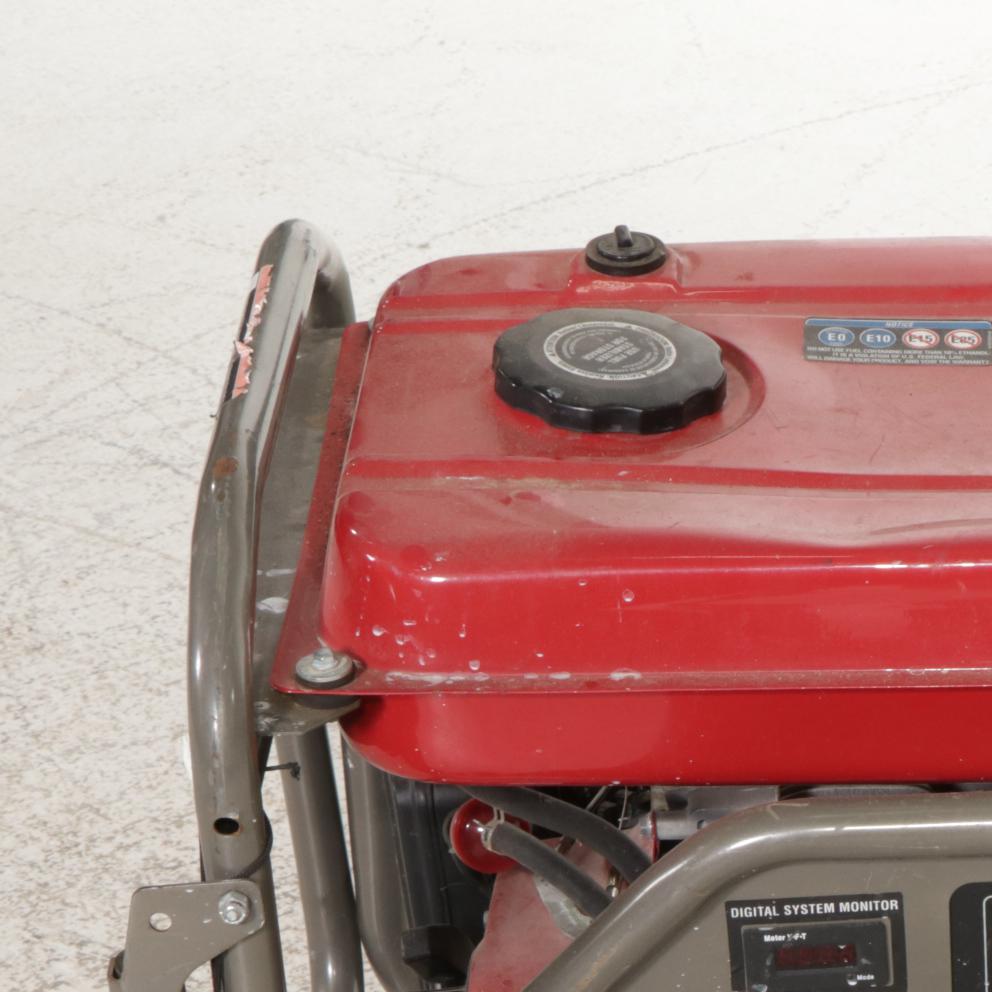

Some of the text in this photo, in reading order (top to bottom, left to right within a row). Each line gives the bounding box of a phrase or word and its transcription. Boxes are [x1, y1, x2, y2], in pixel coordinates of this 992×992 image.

[827, 332, 846, 341] E0
[866, 334, 890, 343] E10
[731, 899, 899, 918] DIGITAL SYSTEM MONITOR
